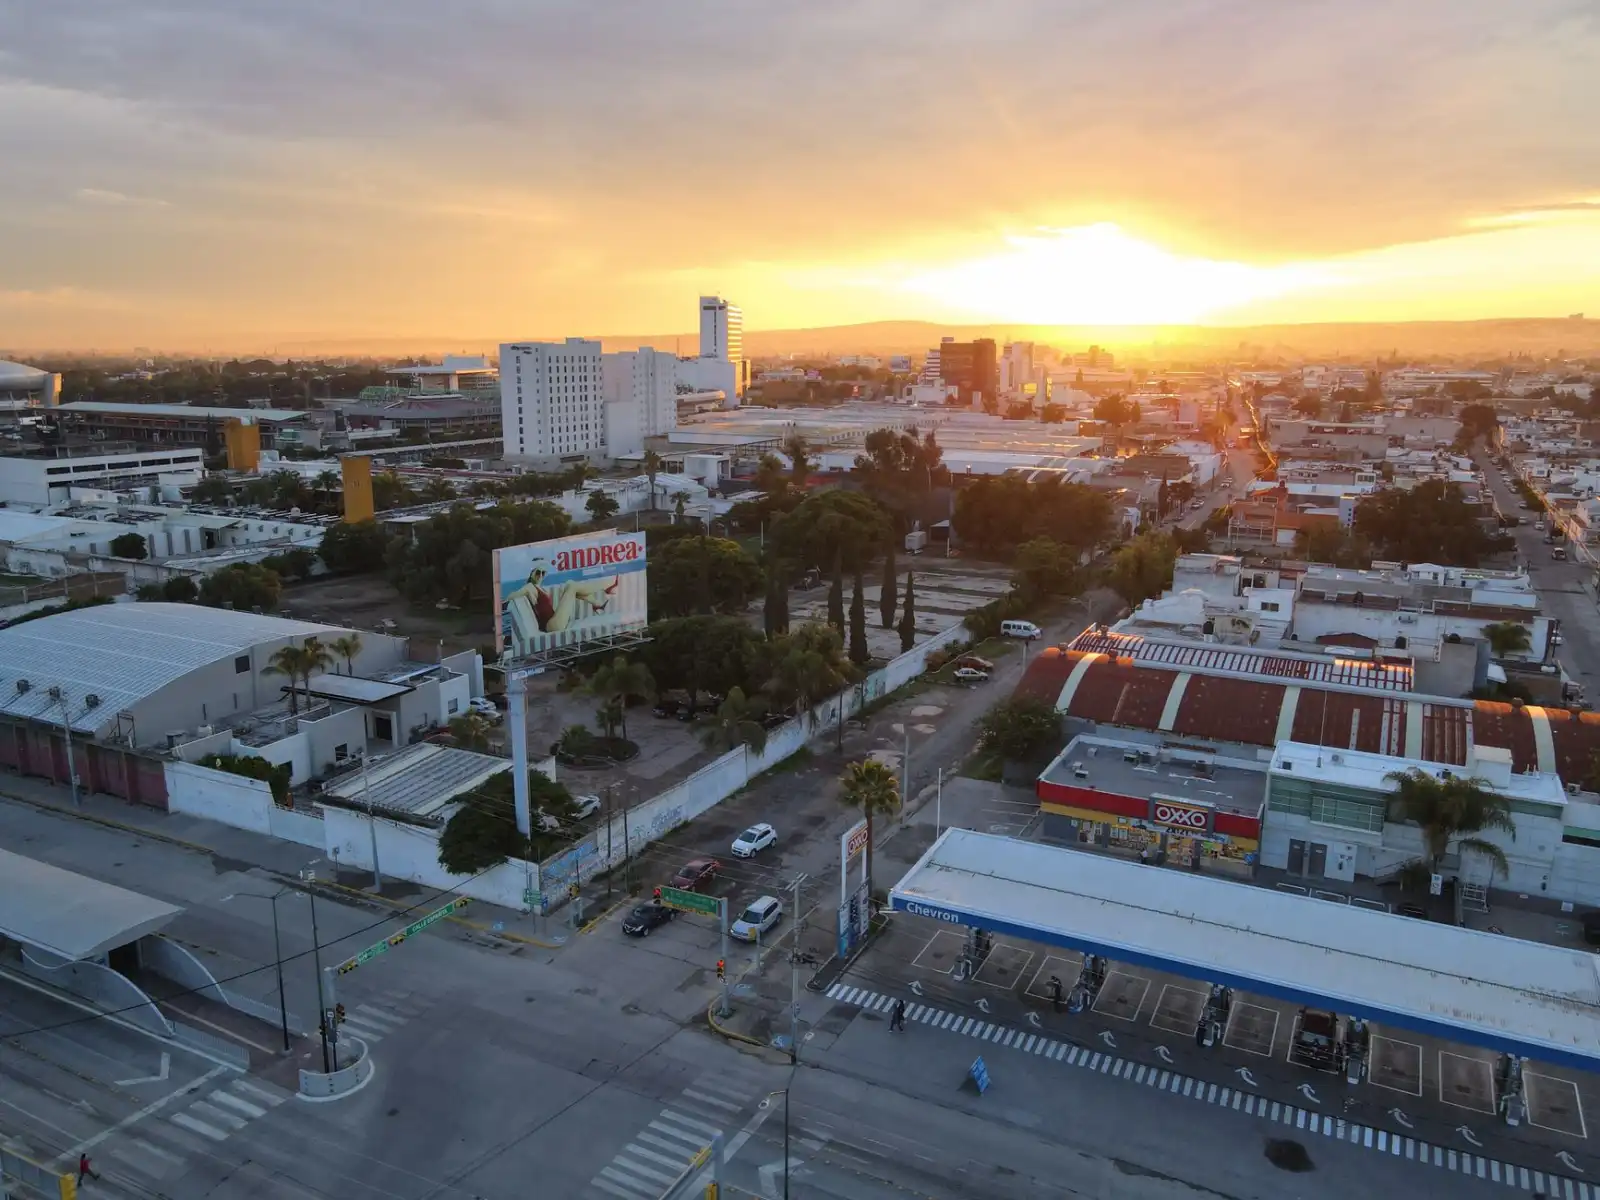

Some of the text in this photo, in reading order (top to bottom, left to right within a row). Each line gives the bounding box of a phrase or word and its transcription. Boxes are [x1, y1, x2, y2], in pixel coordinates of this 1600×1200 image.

[1156, 806, 1206, 827] OXXO
[847, 829, 868, 855] OXXO
[906, 902, 959, 923] Chevron
